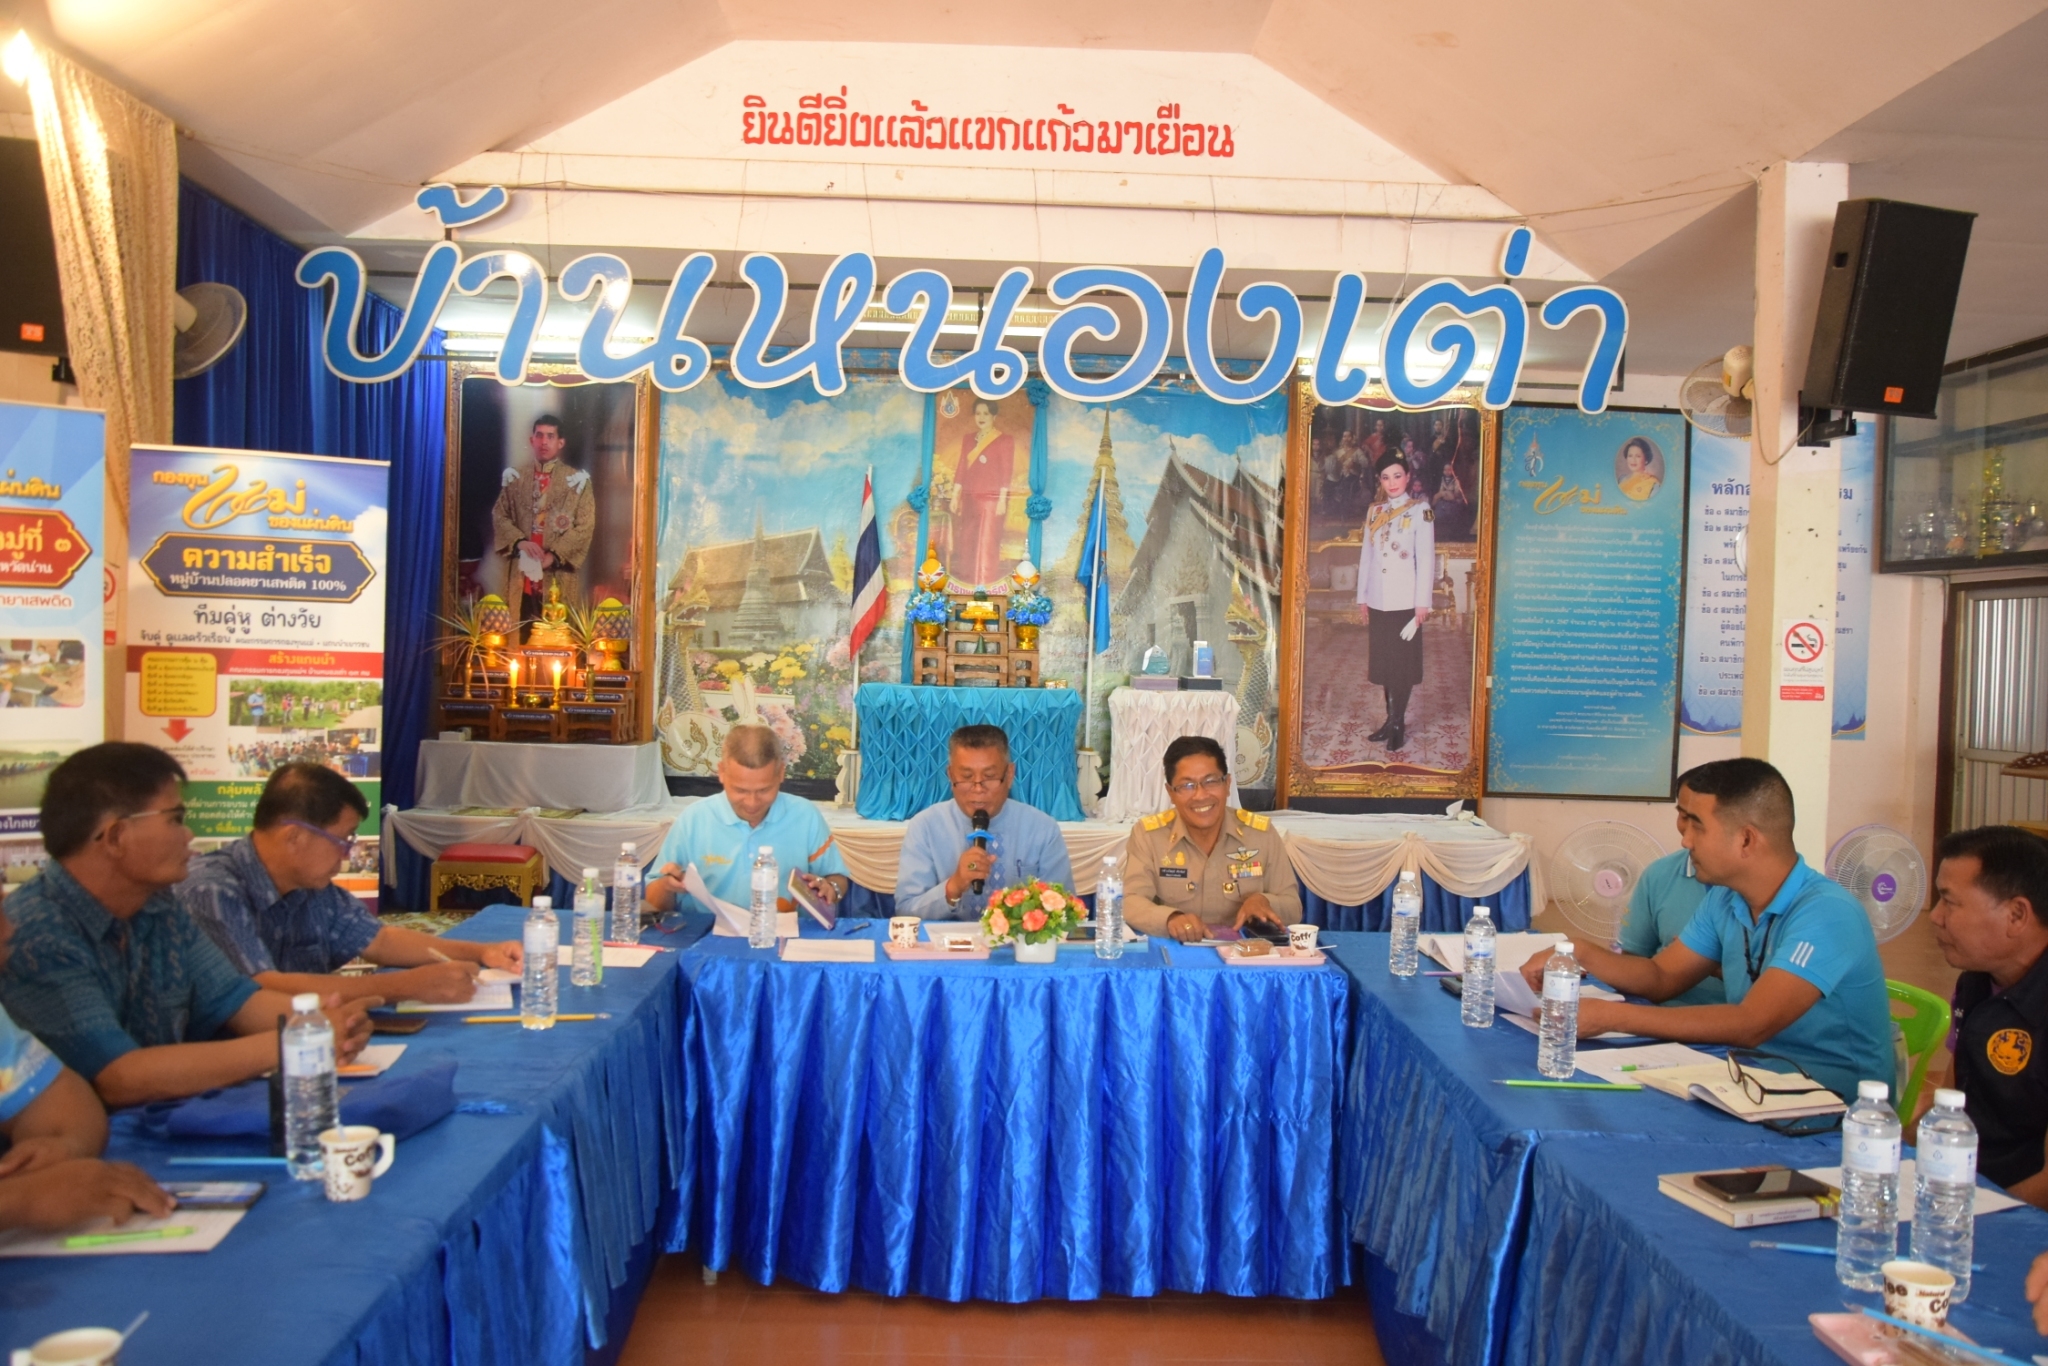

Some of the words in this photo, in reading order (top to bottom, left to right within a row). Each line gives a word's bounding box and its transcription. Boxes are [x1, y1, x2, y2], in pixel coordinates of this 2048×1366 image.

[296, 182, 1631, 413] บ้านหนองเต่า
[153, 470, 209, 490] กองทุน
[268, 508, 354, 533] ของแผ่นดิน
[1724, 506, 1750, 516] สมาชิก
[54, 538, 72, 552] ๓
[182, 544, 331, 574] ความสำเร็จ
[170, 571, 307, 591] หมู่บ้านปลอดยาเสพติด
[311, 579, 347, 592] 100%
[194, 604, 251, 635] ทีมคู่หู
[261, 606, 321, 629] ต่างวัย
[1718, 687, 1744, 696] สมาชิก
